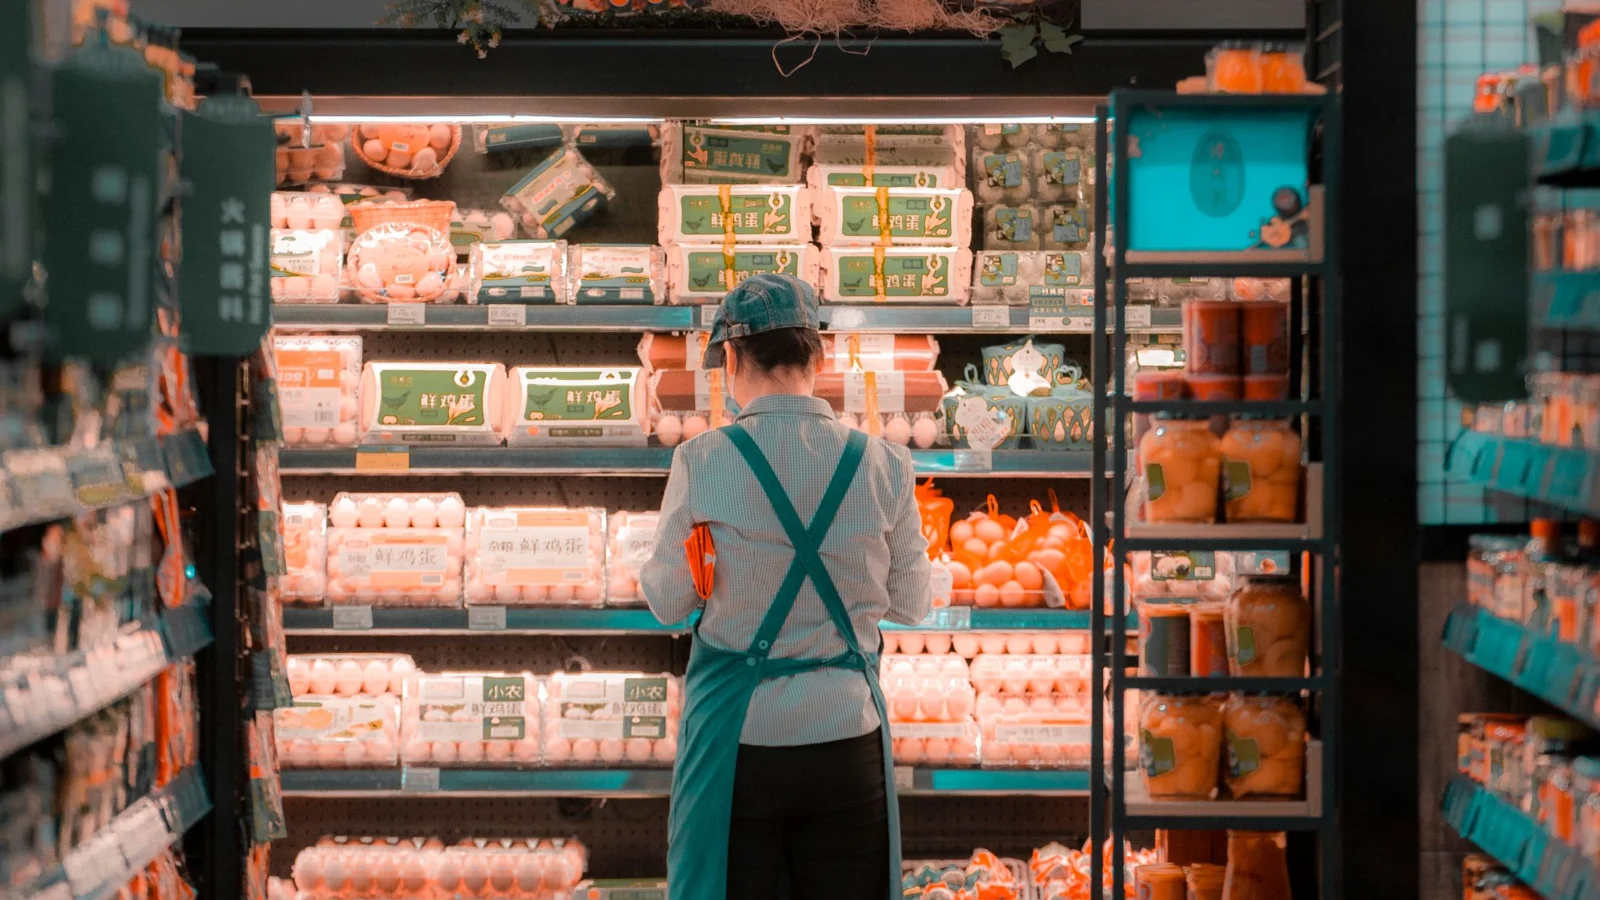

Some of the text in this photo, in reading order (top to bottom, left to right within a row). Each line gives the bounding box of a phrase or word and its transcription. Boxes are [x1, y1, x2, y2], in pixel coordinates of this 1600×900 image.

[711, 211, 759, 228] 鲜鸡蛋
[420, 393, 476, 409] 鲜鸡蛋
[566, 389, 621, 405] 鲜鸡蛋
[519, 537, 584, 555] 鲜鸡蛋
[374, 547, 437, 566] 鲜鸡蛋
[487, 685, 522, 699] 小农
[629, 685, 664, 699] 小农
